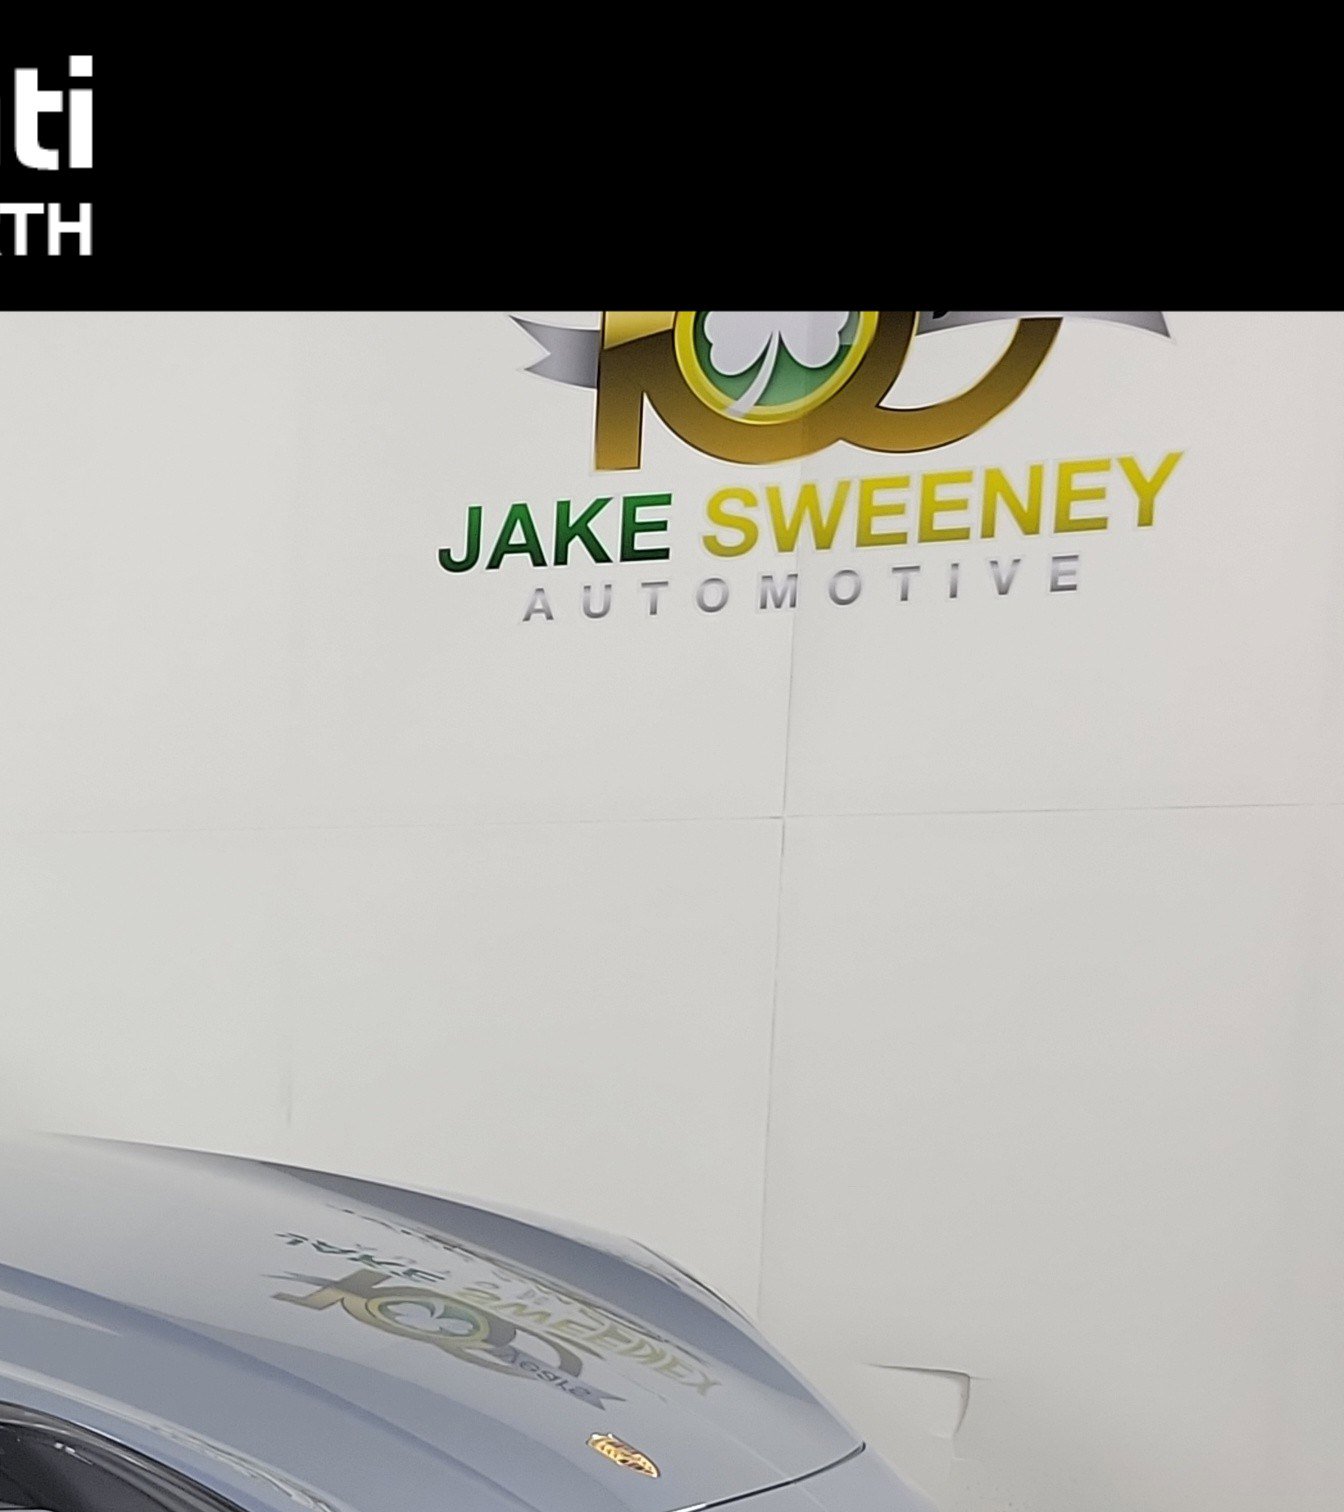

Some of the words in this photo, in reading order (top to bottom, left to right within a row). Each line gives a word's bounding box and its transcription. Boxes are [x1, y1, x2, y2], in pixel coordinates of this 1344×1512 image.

[438, 493, 673, 574] JAKE
[702, 451, 1185, 558] SWEENEY
[522, 553, 1081, 622] AUTOMOTIVE
